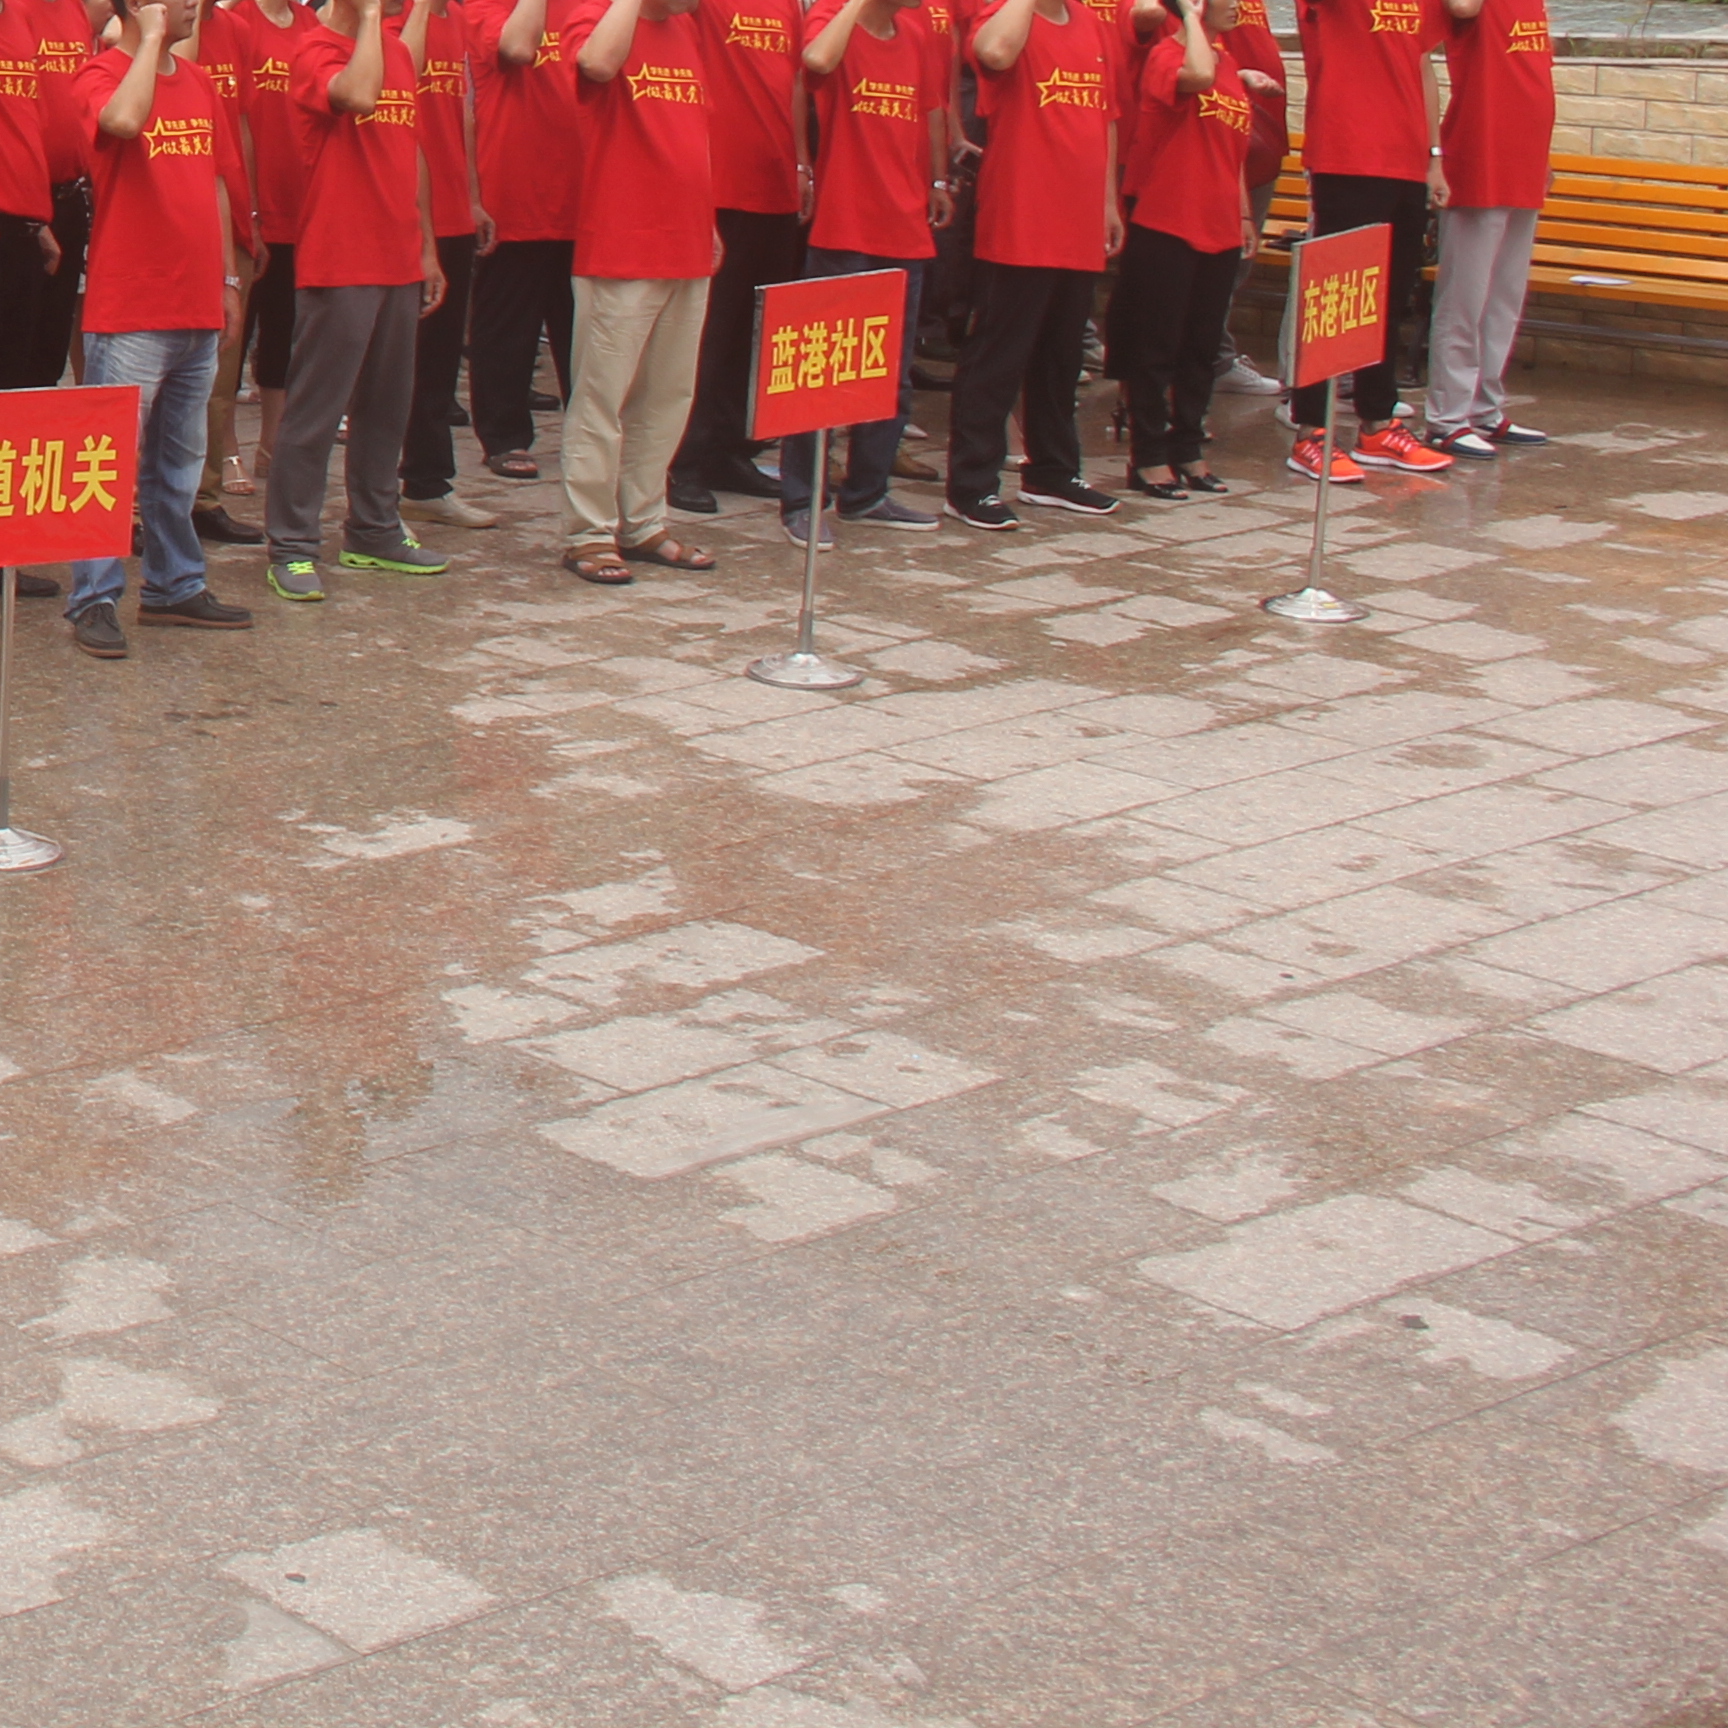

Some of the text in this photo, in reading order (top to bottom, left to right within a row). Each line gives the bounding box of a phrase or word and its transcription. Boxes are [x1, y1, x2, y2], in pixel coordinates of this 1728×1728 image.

[1301, 265, 1380, 344] 东港社区
[766, 314, 890, 395] 蓝港社区
